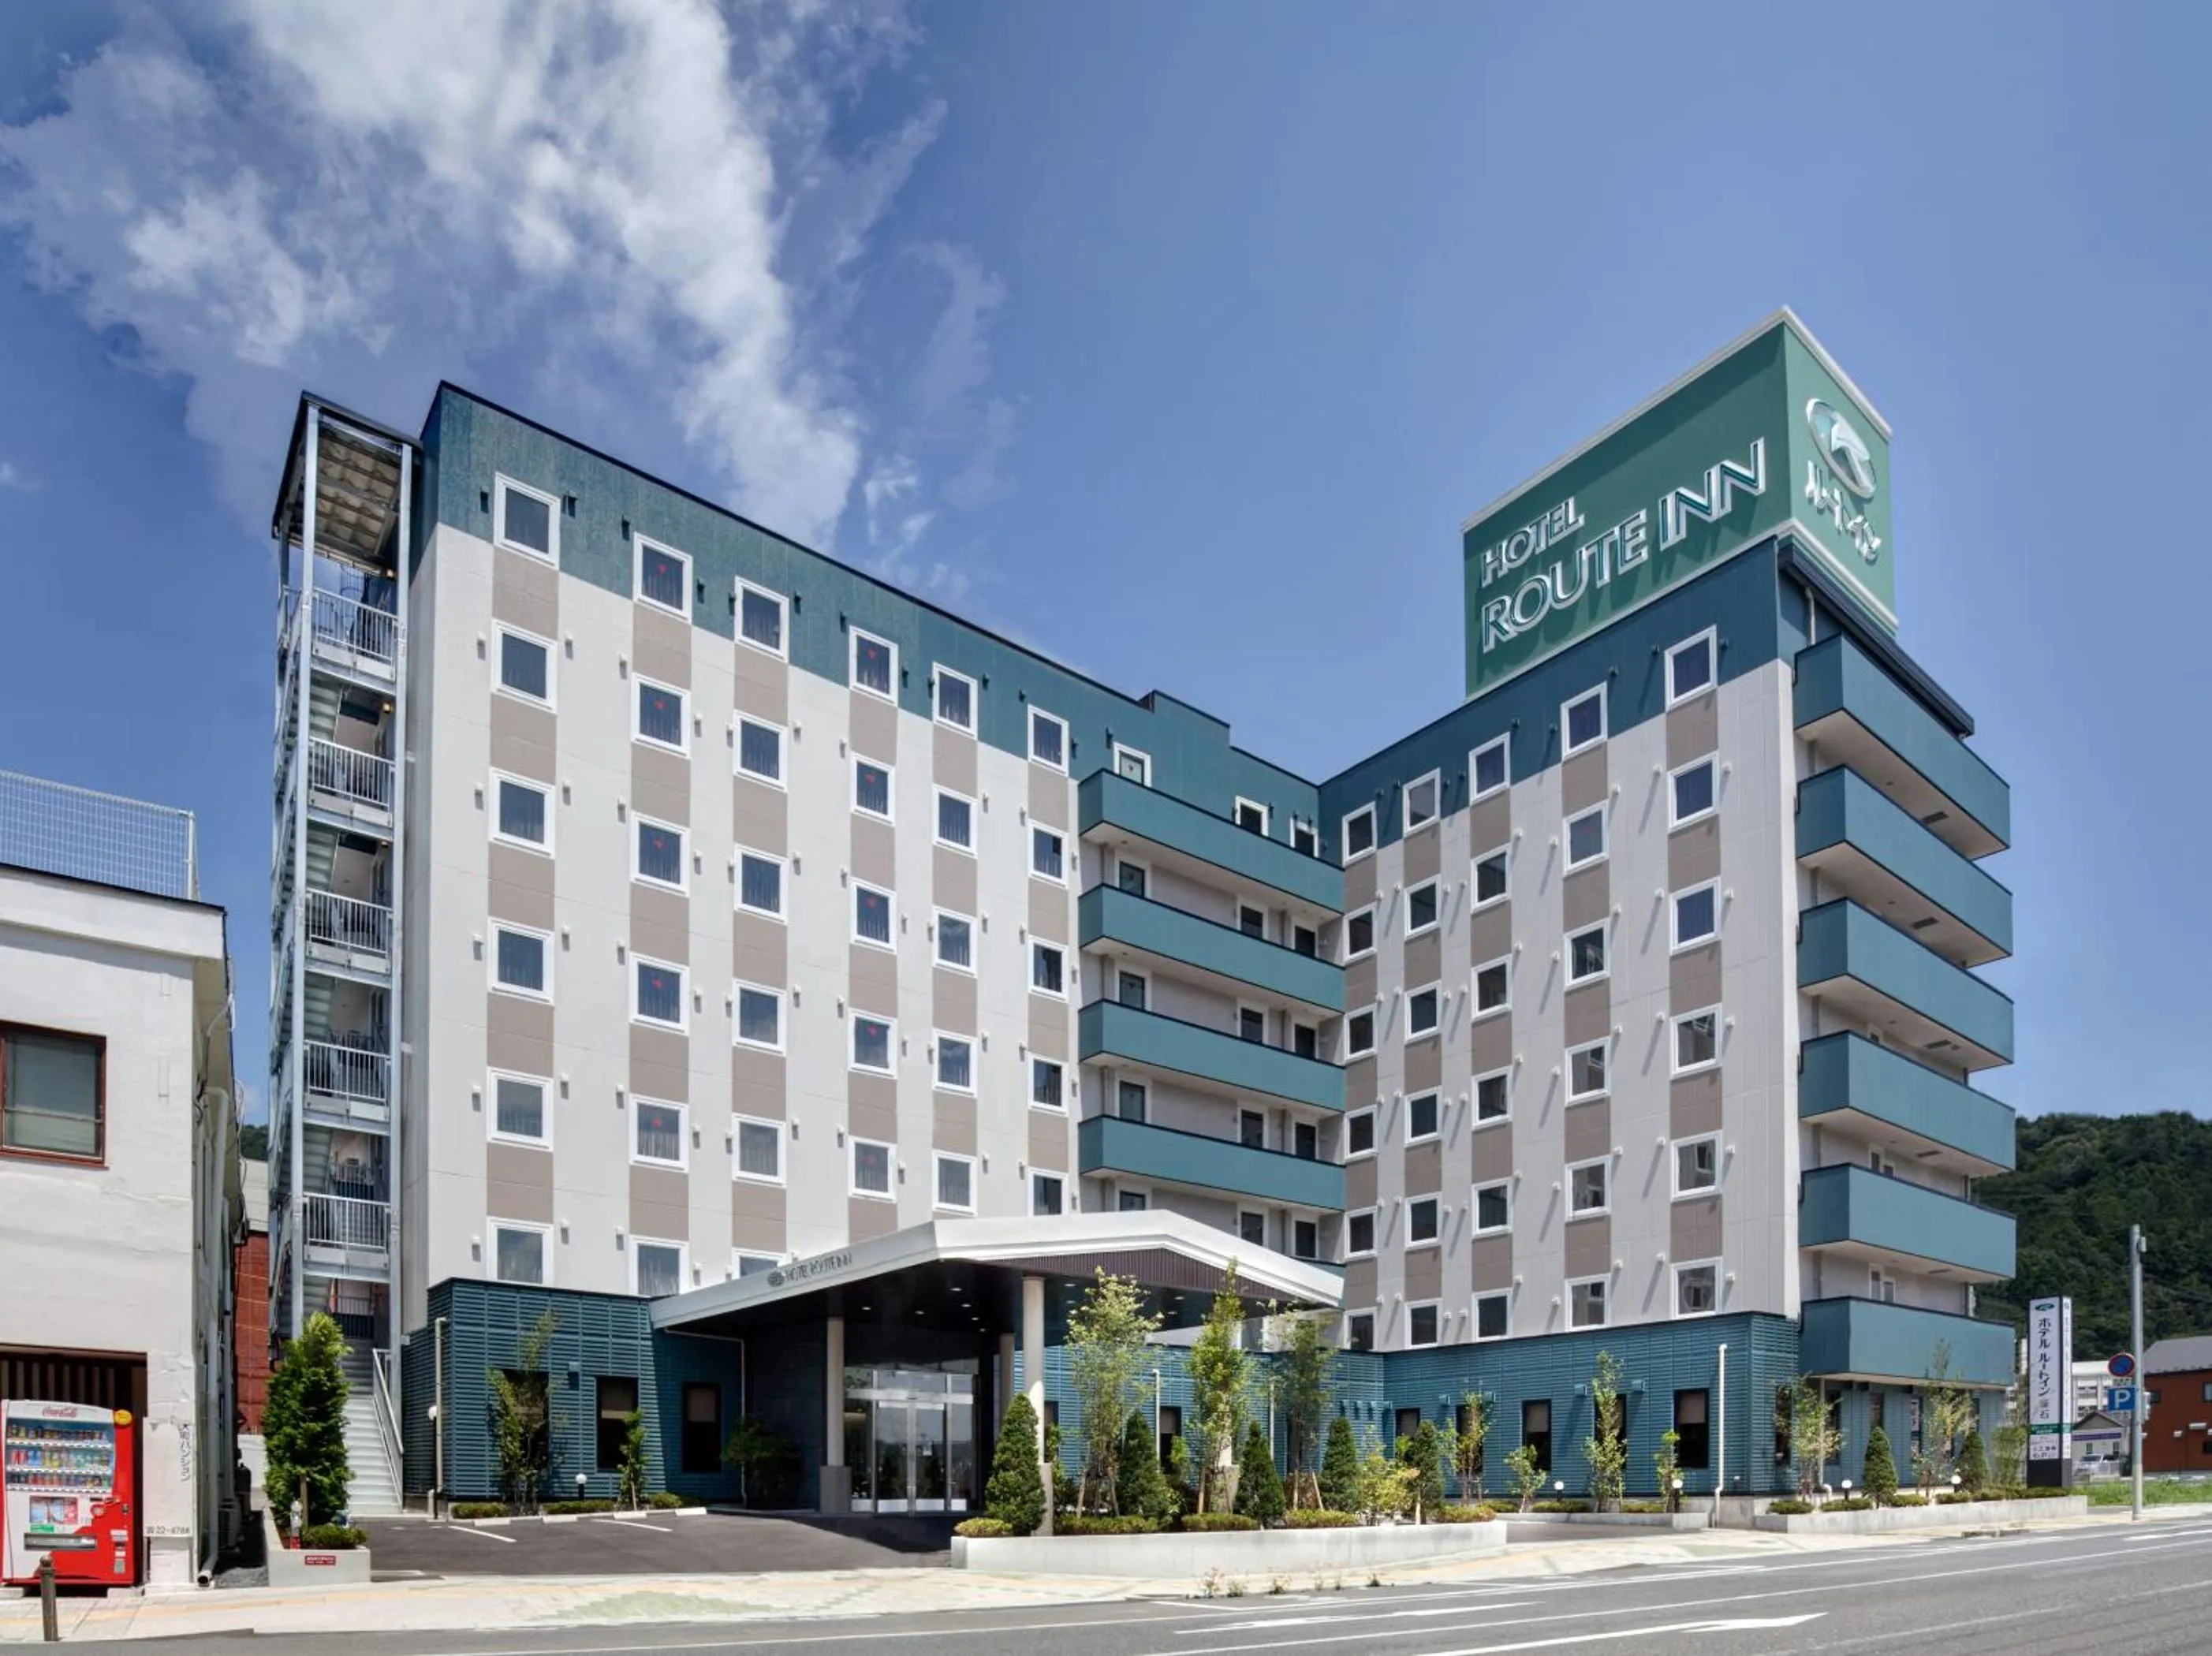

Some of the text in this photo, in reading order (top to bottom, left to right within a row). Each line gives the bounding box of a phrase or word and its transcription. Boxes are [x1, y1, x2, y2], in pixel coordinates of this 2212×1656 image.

[1481, 496, 1584, 588] HOTEL
[1481, 436, 1766, 654] ROUTE INN
[2114, 1389, 2131, 1409] P
